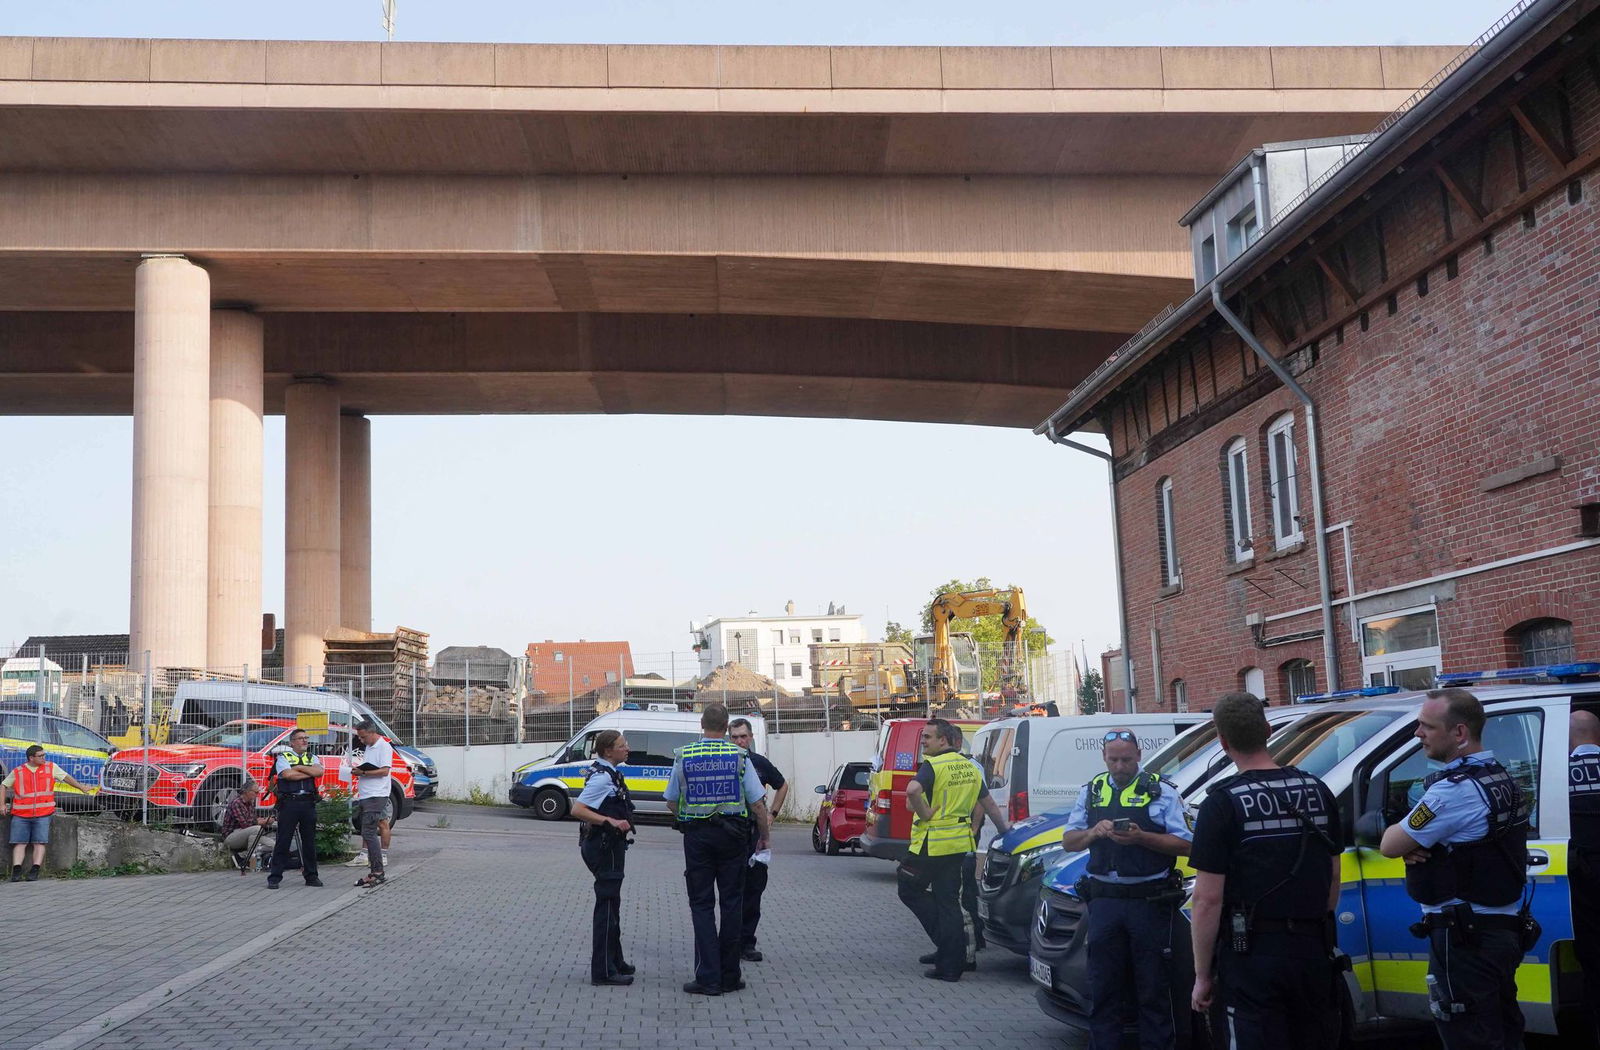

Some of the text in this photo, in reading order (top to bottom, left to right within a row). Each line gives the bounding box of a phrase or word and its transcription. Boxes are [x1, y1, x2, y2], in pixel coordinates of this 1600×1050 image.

[1075, 737, 1104, 751] CHRIS
[684, 760, 736, 773] Einsatzleitung
[1571, 764, 1600, 783] OLI
[689, 781, 735, 796] POLIZEI
[1239, 788, 1325, 818] POLIZEI
